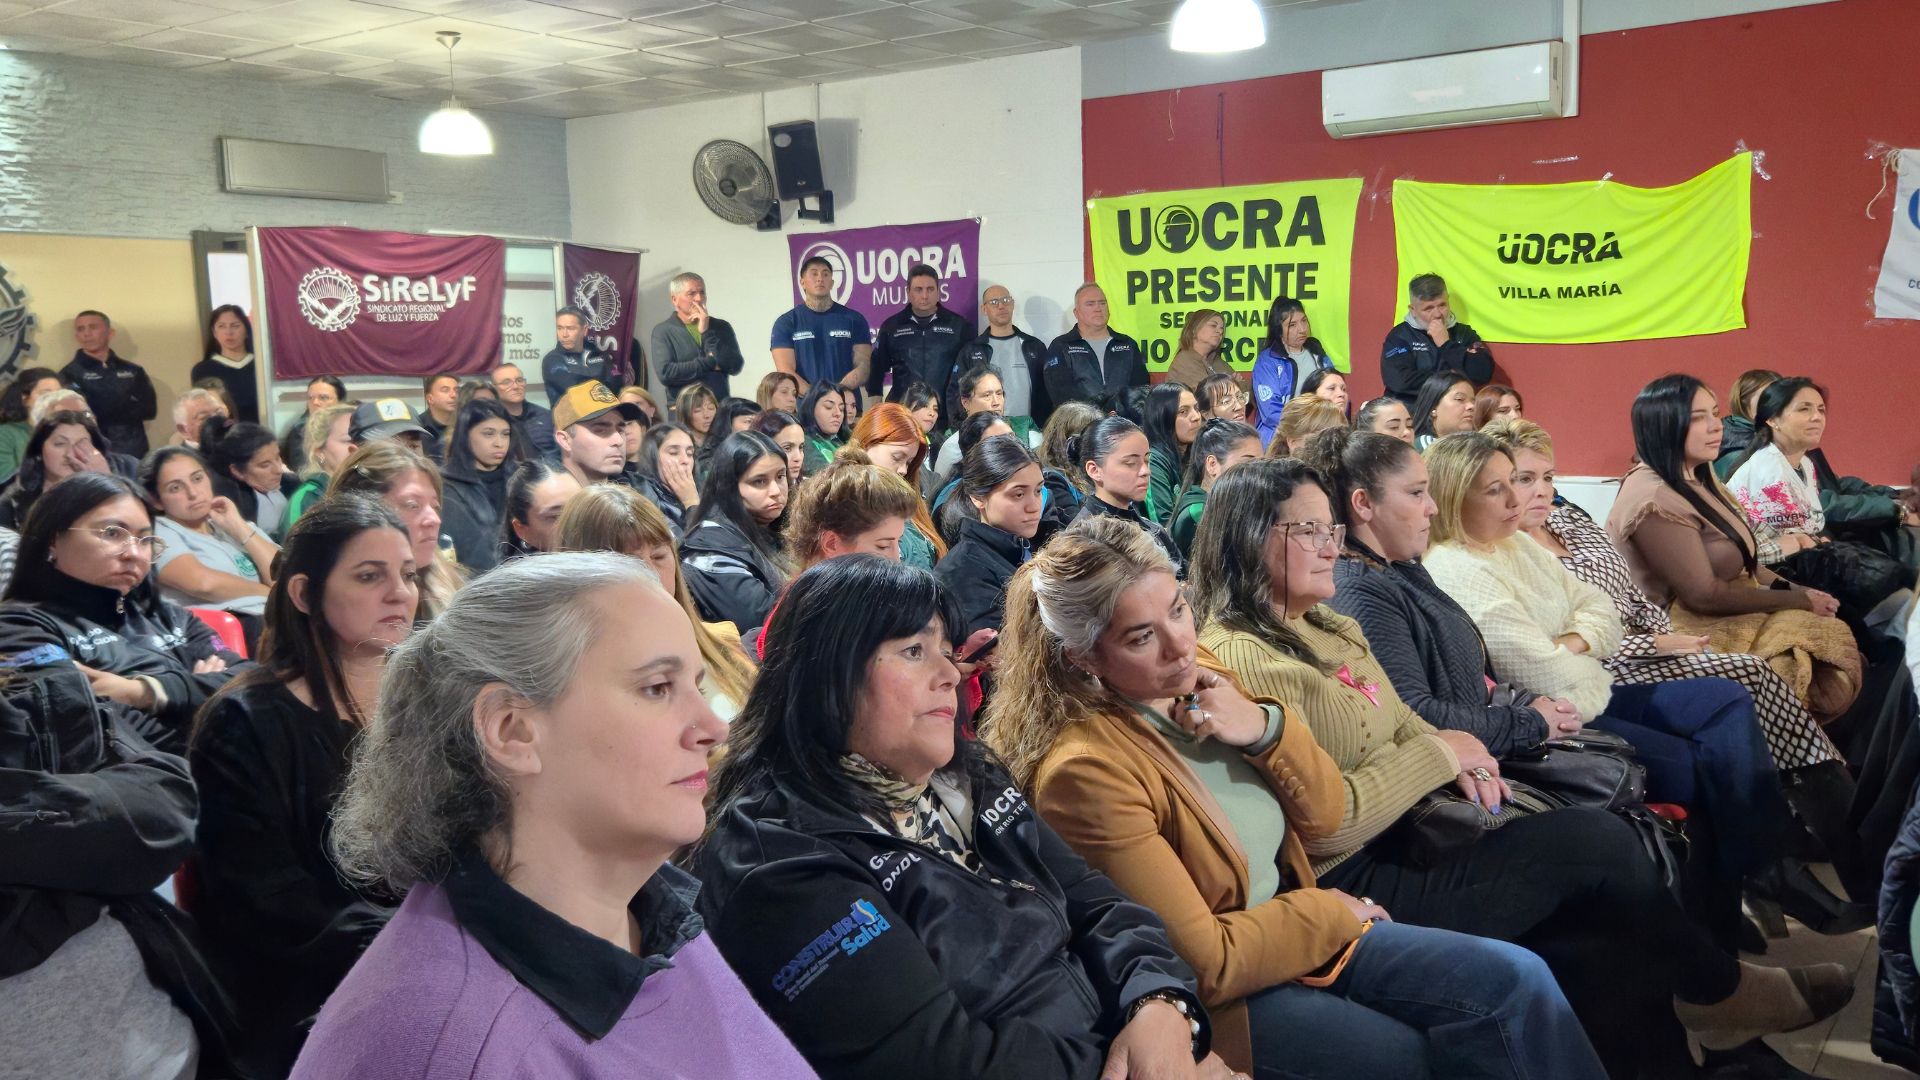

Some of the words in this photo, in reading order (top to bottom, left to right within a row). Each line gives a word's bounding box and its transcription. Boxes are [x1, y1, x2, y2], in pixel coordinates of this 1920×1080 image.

[856, 243, 967, 285] UOCRA
[1497, 231, 1623, 265] UOCRA
[363, 274, 477, 309] SiReLyF
[873, 283, 950, 306] MUJS
[1127, 262, 1319, 306] PRESENTE
[1498, 286, 1551, 299] VILLA
[1557, 281, 1623, 299] MARÍA
[367, 303, 408, 314] SINDICATO
[409, 303, 446, 313] REGIONAL
[376, 313, 388, 322] DE
[388, 313, 403, 322] LUZ
[403, 313, 410, 321] Y
[410, 312, 440, 322] FUERZA
[841, 912, 892, 956] Salud
